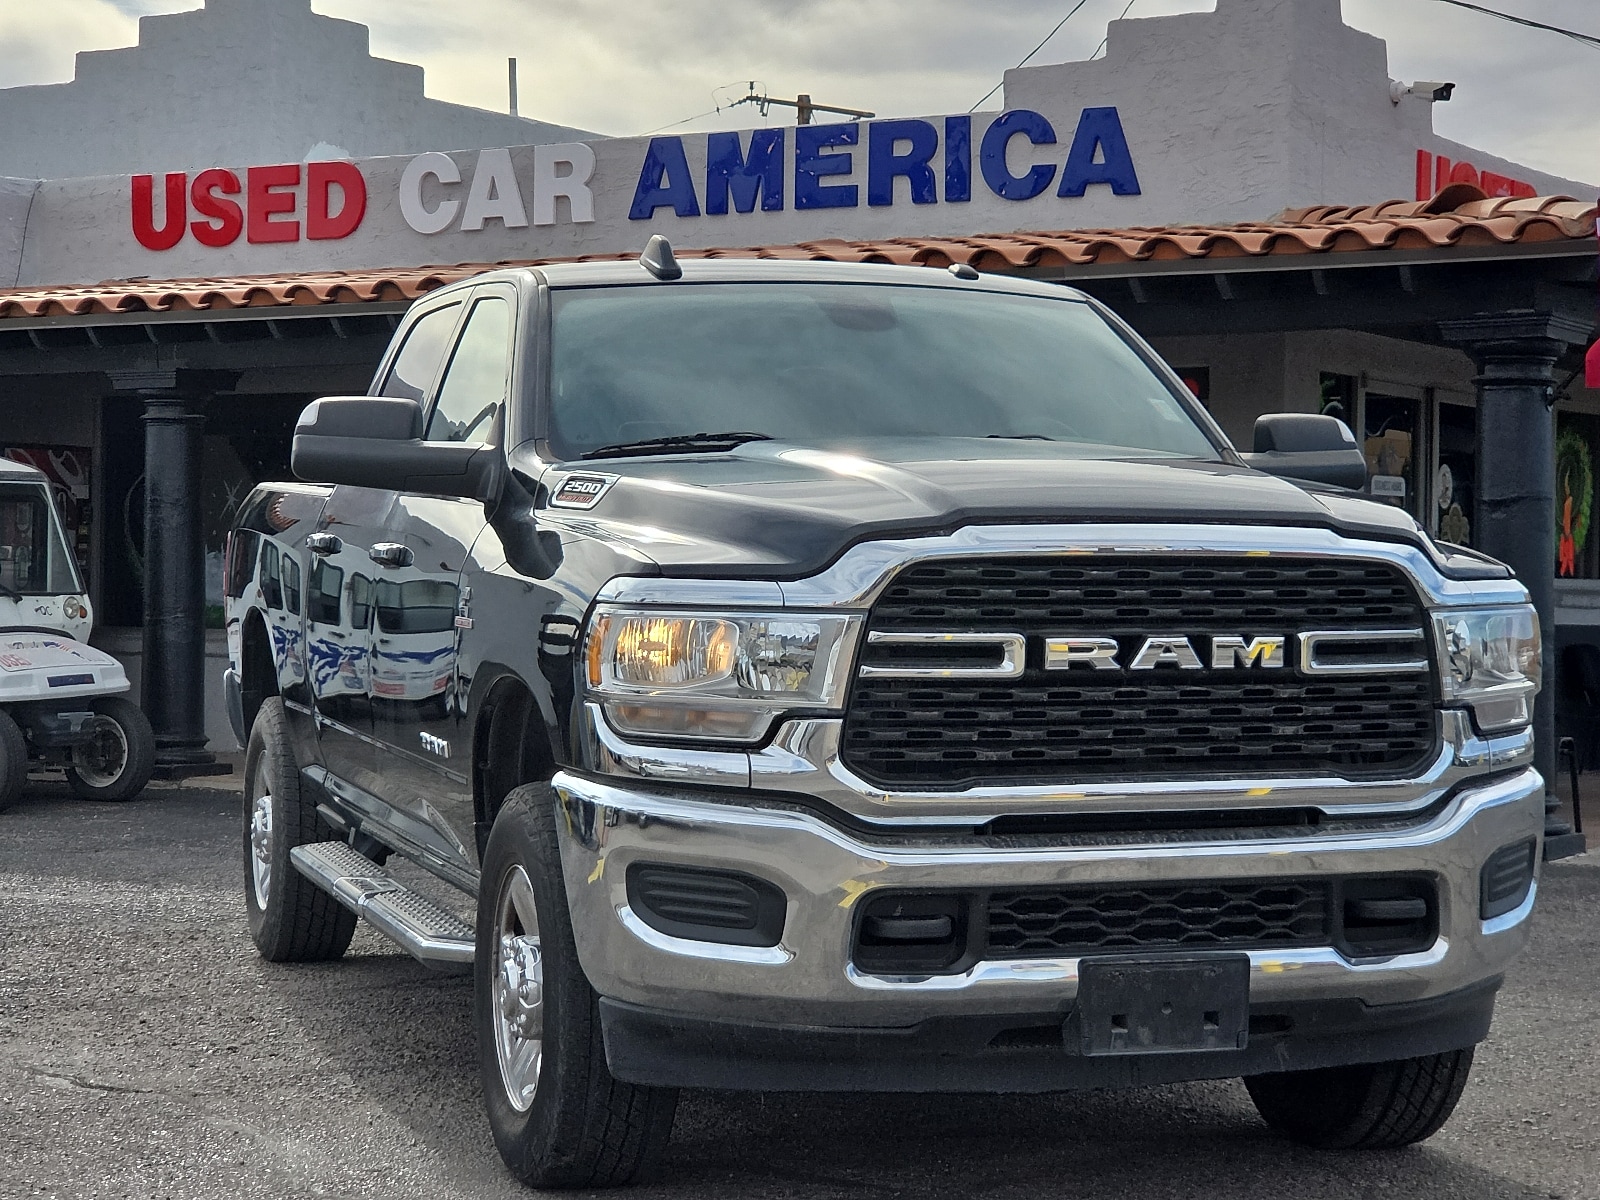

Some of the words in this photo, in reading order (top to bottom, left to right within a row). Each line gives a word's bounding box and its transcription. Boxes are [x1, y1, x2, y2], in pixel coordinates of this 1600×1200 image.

[131, 161, 367, 250] USED
[399, 142, 596, 234] CAR
[628, 106, 1141, 221] AMERICA
[563, 481, 602, 494] 2500
[1045, 637, 1286, 669] RAM
[419, 731, 450, 759] RAM
